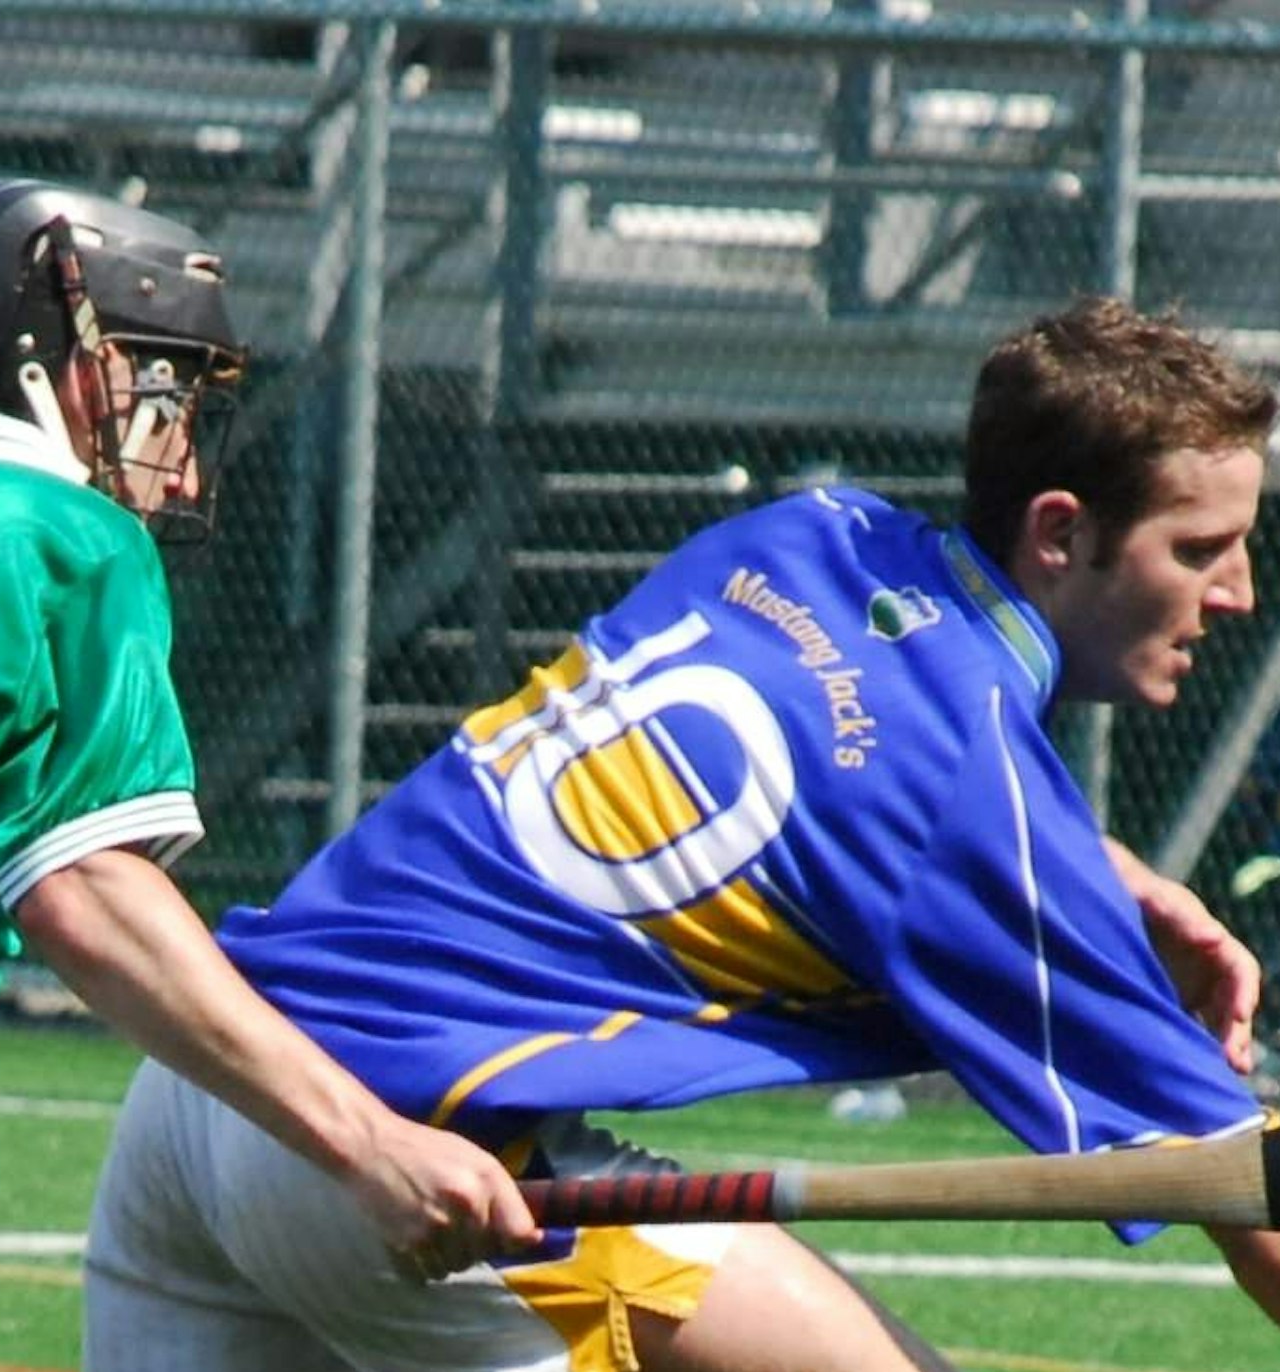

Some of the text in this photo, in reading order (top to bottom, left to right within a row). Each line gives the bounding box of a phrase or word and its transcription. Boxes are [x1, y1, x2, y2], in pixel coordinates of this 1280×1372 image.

[470, 610, 796, 918] 10
[722, 567, 877, 768] Mustang Jack's
